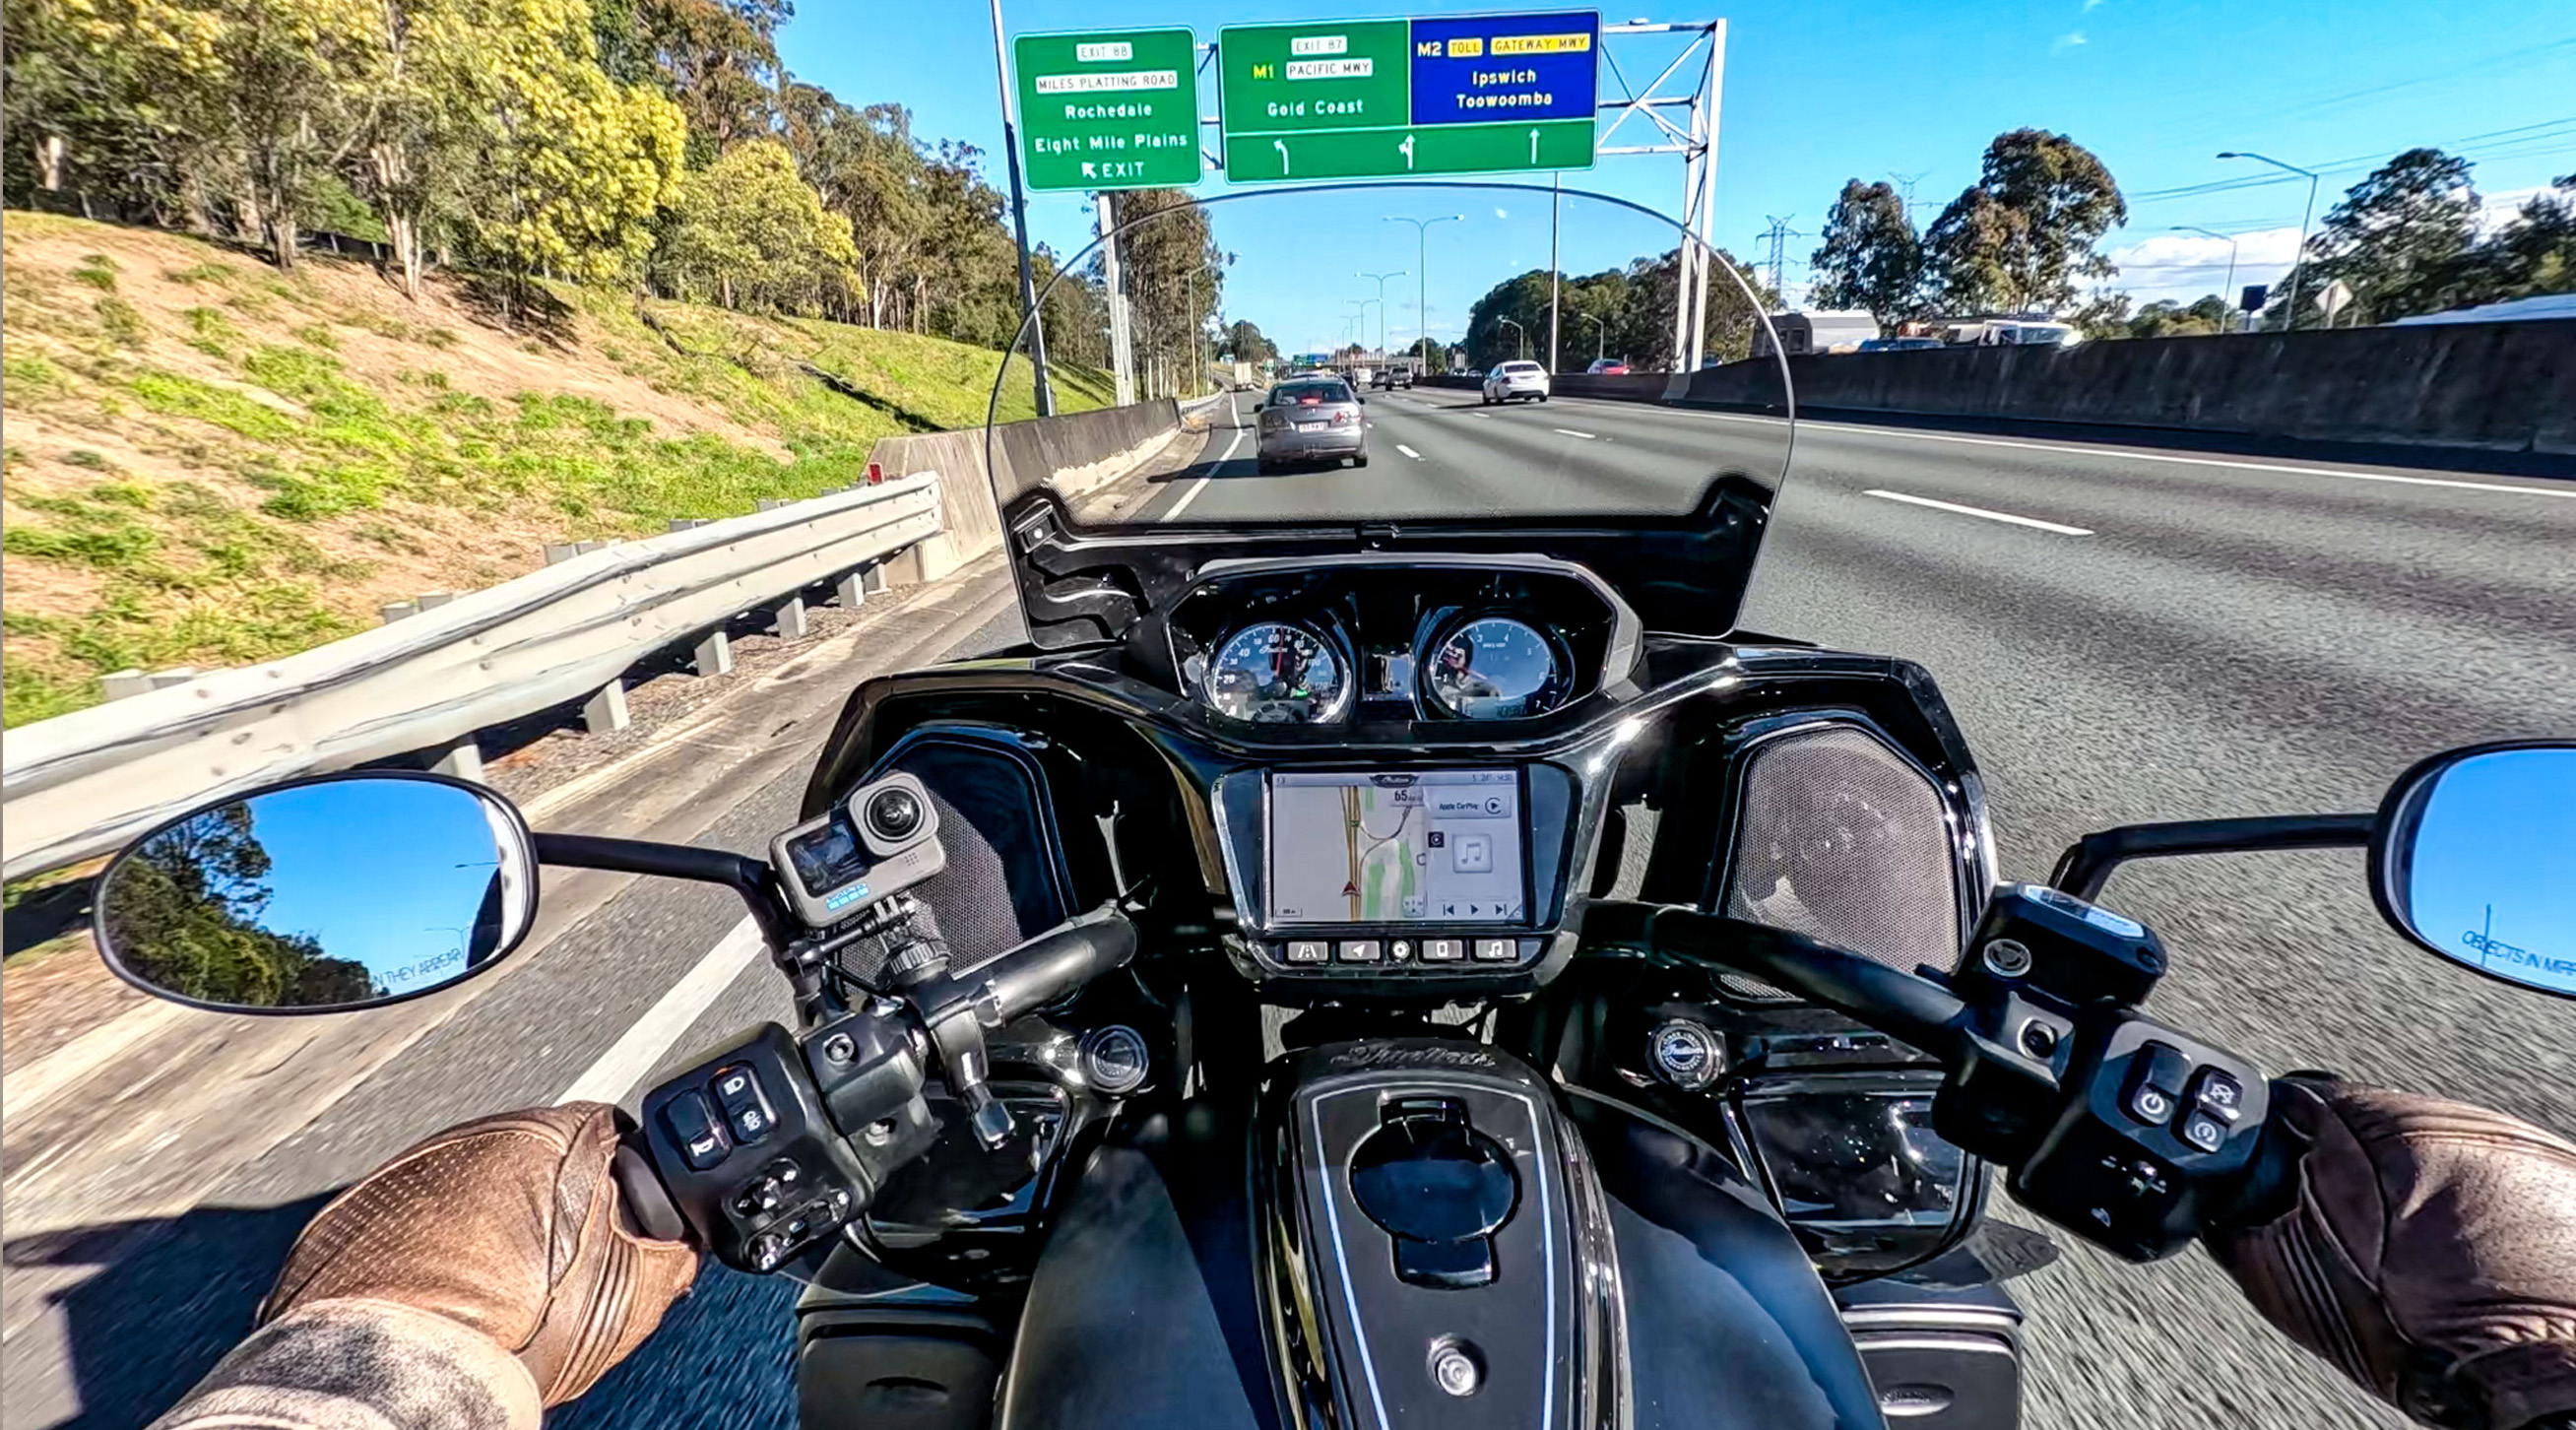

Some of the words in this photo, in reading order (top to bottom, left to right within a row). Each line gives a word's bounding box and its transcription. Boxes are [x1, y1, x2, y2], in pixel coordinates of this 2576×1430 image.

[1080, 45, 1106, 58] EXIT
[1113, 45, 1128, 57] 88
[1296, 40, 1320, 52] EXIT
[1417, 41, 1442, 57] M2
[1450, 41, 1480, 53] TOLL
[1494, 38, 1552, 52] GATEWAY
[1558, 36, 1587, 48] MWY
[1253, 63, 1275, 80] M1
[1289, 63, 1337, 76] PACIFIC
[1343, 62, 1370, 73] MWY
[1038, 78, 1074, 90] MILES
[1079, 76, 1137, 89] PLATTING
[1142, 74, 1176, 86] ROAD
[1472, 69, 1537, 88] Ipswich
[1267, 101, 1305, 117] Gold
[1315, 98, 1364, 114] Coast
[1455, 92, 1553, 108] Toowoomba
[1064, 102, 1153, 119] Rochedale
[1034, 137, 1080, 156] Eight
[1088, 135, 1126, 150] Mile
[1134, 133, 1188, 148] Plains
[1102, 162, 1145, 178] EXIT
[1223, 675, 1235, 684] 20
[1394, 790, 1408, 802] 65
[419, 947, 463, 976] APPEAR
